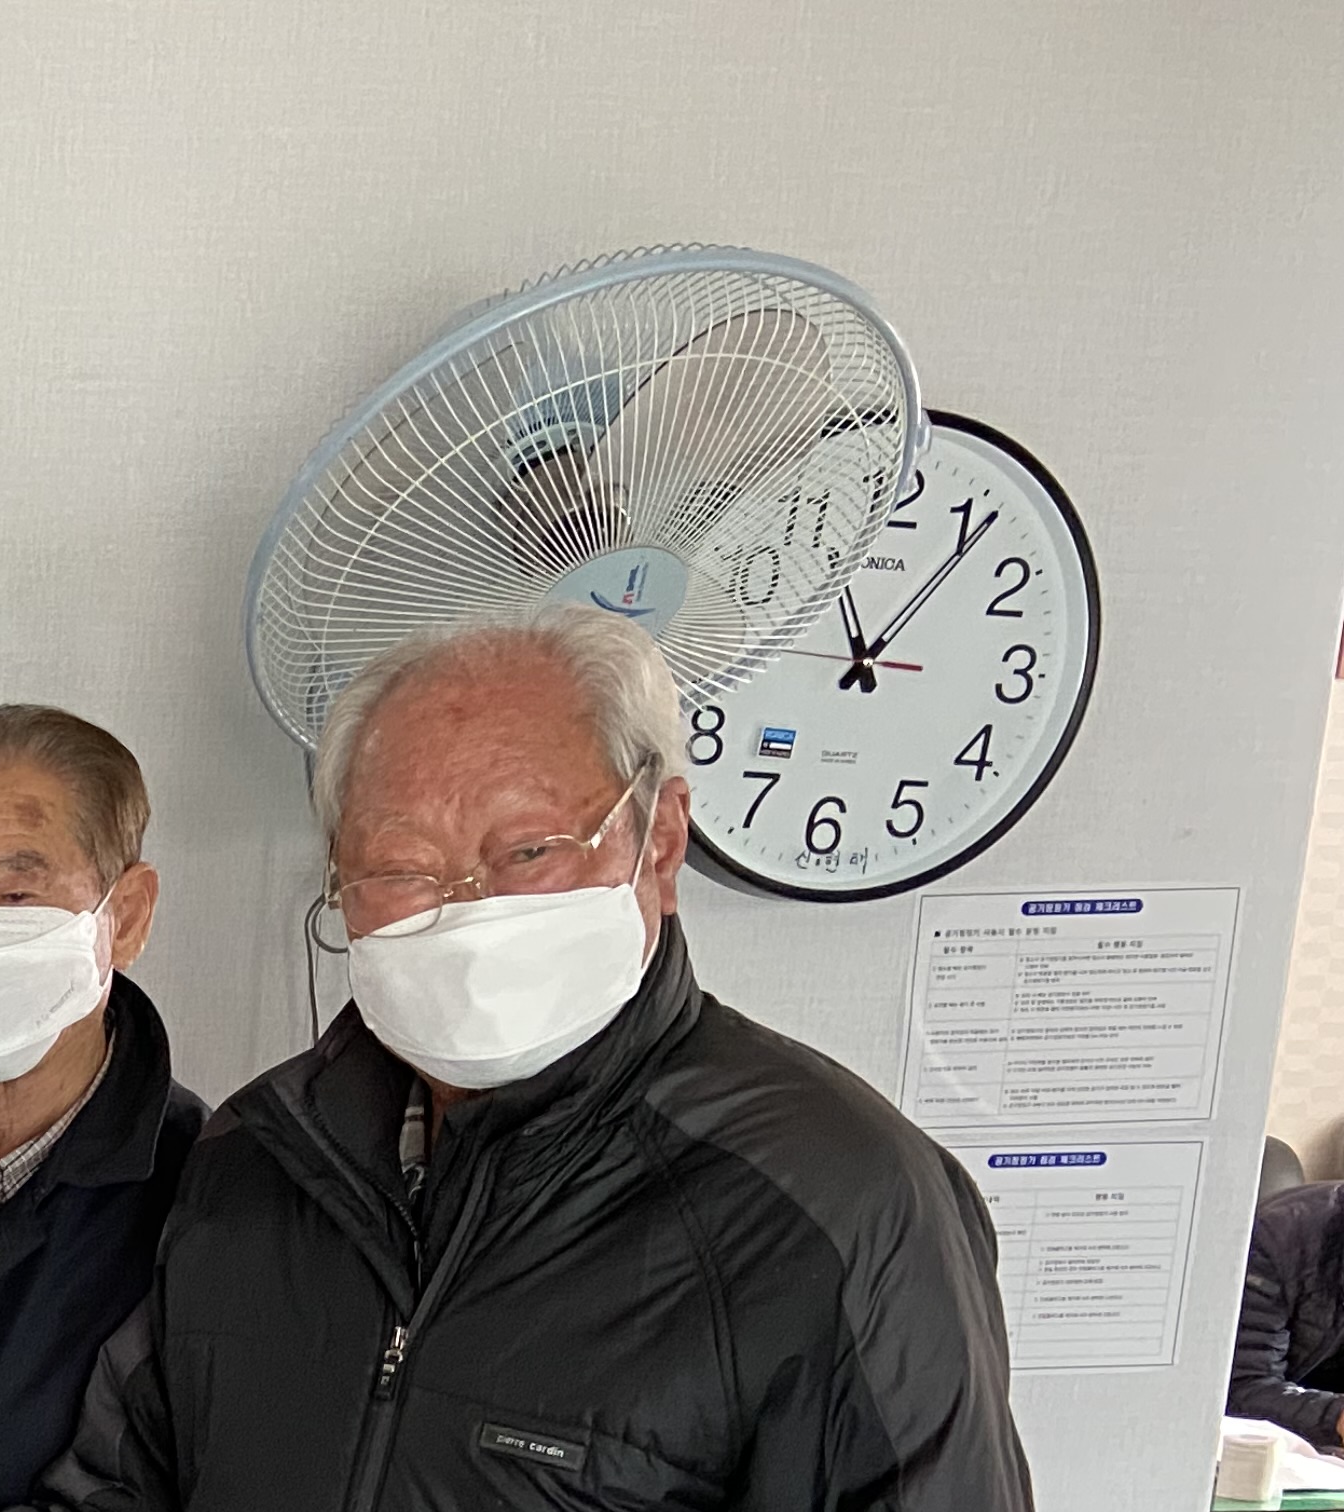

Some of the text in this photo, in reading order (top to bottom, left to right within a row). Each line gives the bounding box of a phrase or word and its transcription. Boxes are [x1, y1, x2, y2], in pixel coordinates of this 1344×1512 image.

[950, 498, 974, 556] 1
[986, 556, 1031, 618] 2
[995, 643, 1037, 704] 3
[685, 705, 725, 766] 8
[953, 723, 994, 782] 4
[742, 770, 781, 829] 7
[805, 796, 847, 855] 6
[885, 779, 929, 838] 5
[529, 1442, 564, 1458] cardin
